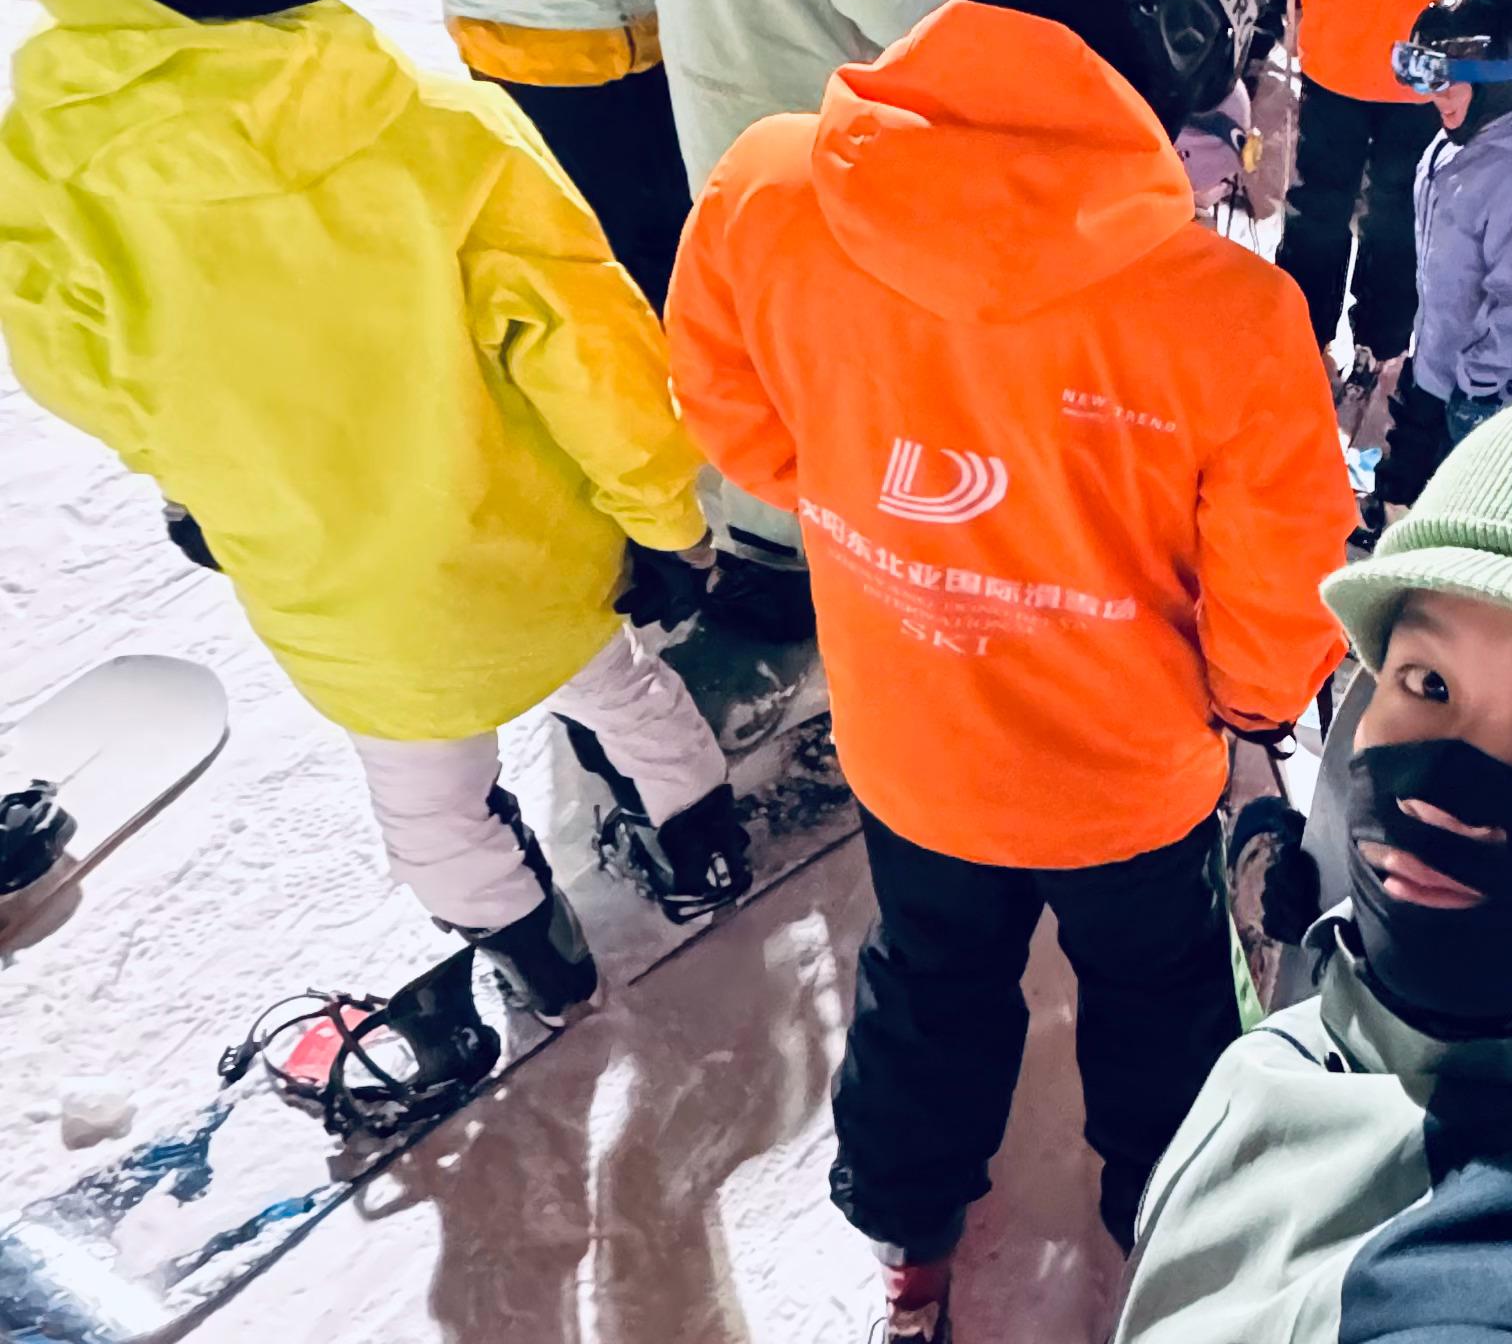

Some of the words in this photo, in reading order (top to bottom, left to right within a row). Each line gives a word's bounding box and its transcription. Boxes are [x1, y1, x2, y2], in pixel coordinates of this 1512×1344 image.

[1061, 387, 1107, 408] NEW
[1113, 405, 1177, 433] TREND
[899, 617, 990, 657] SKI
